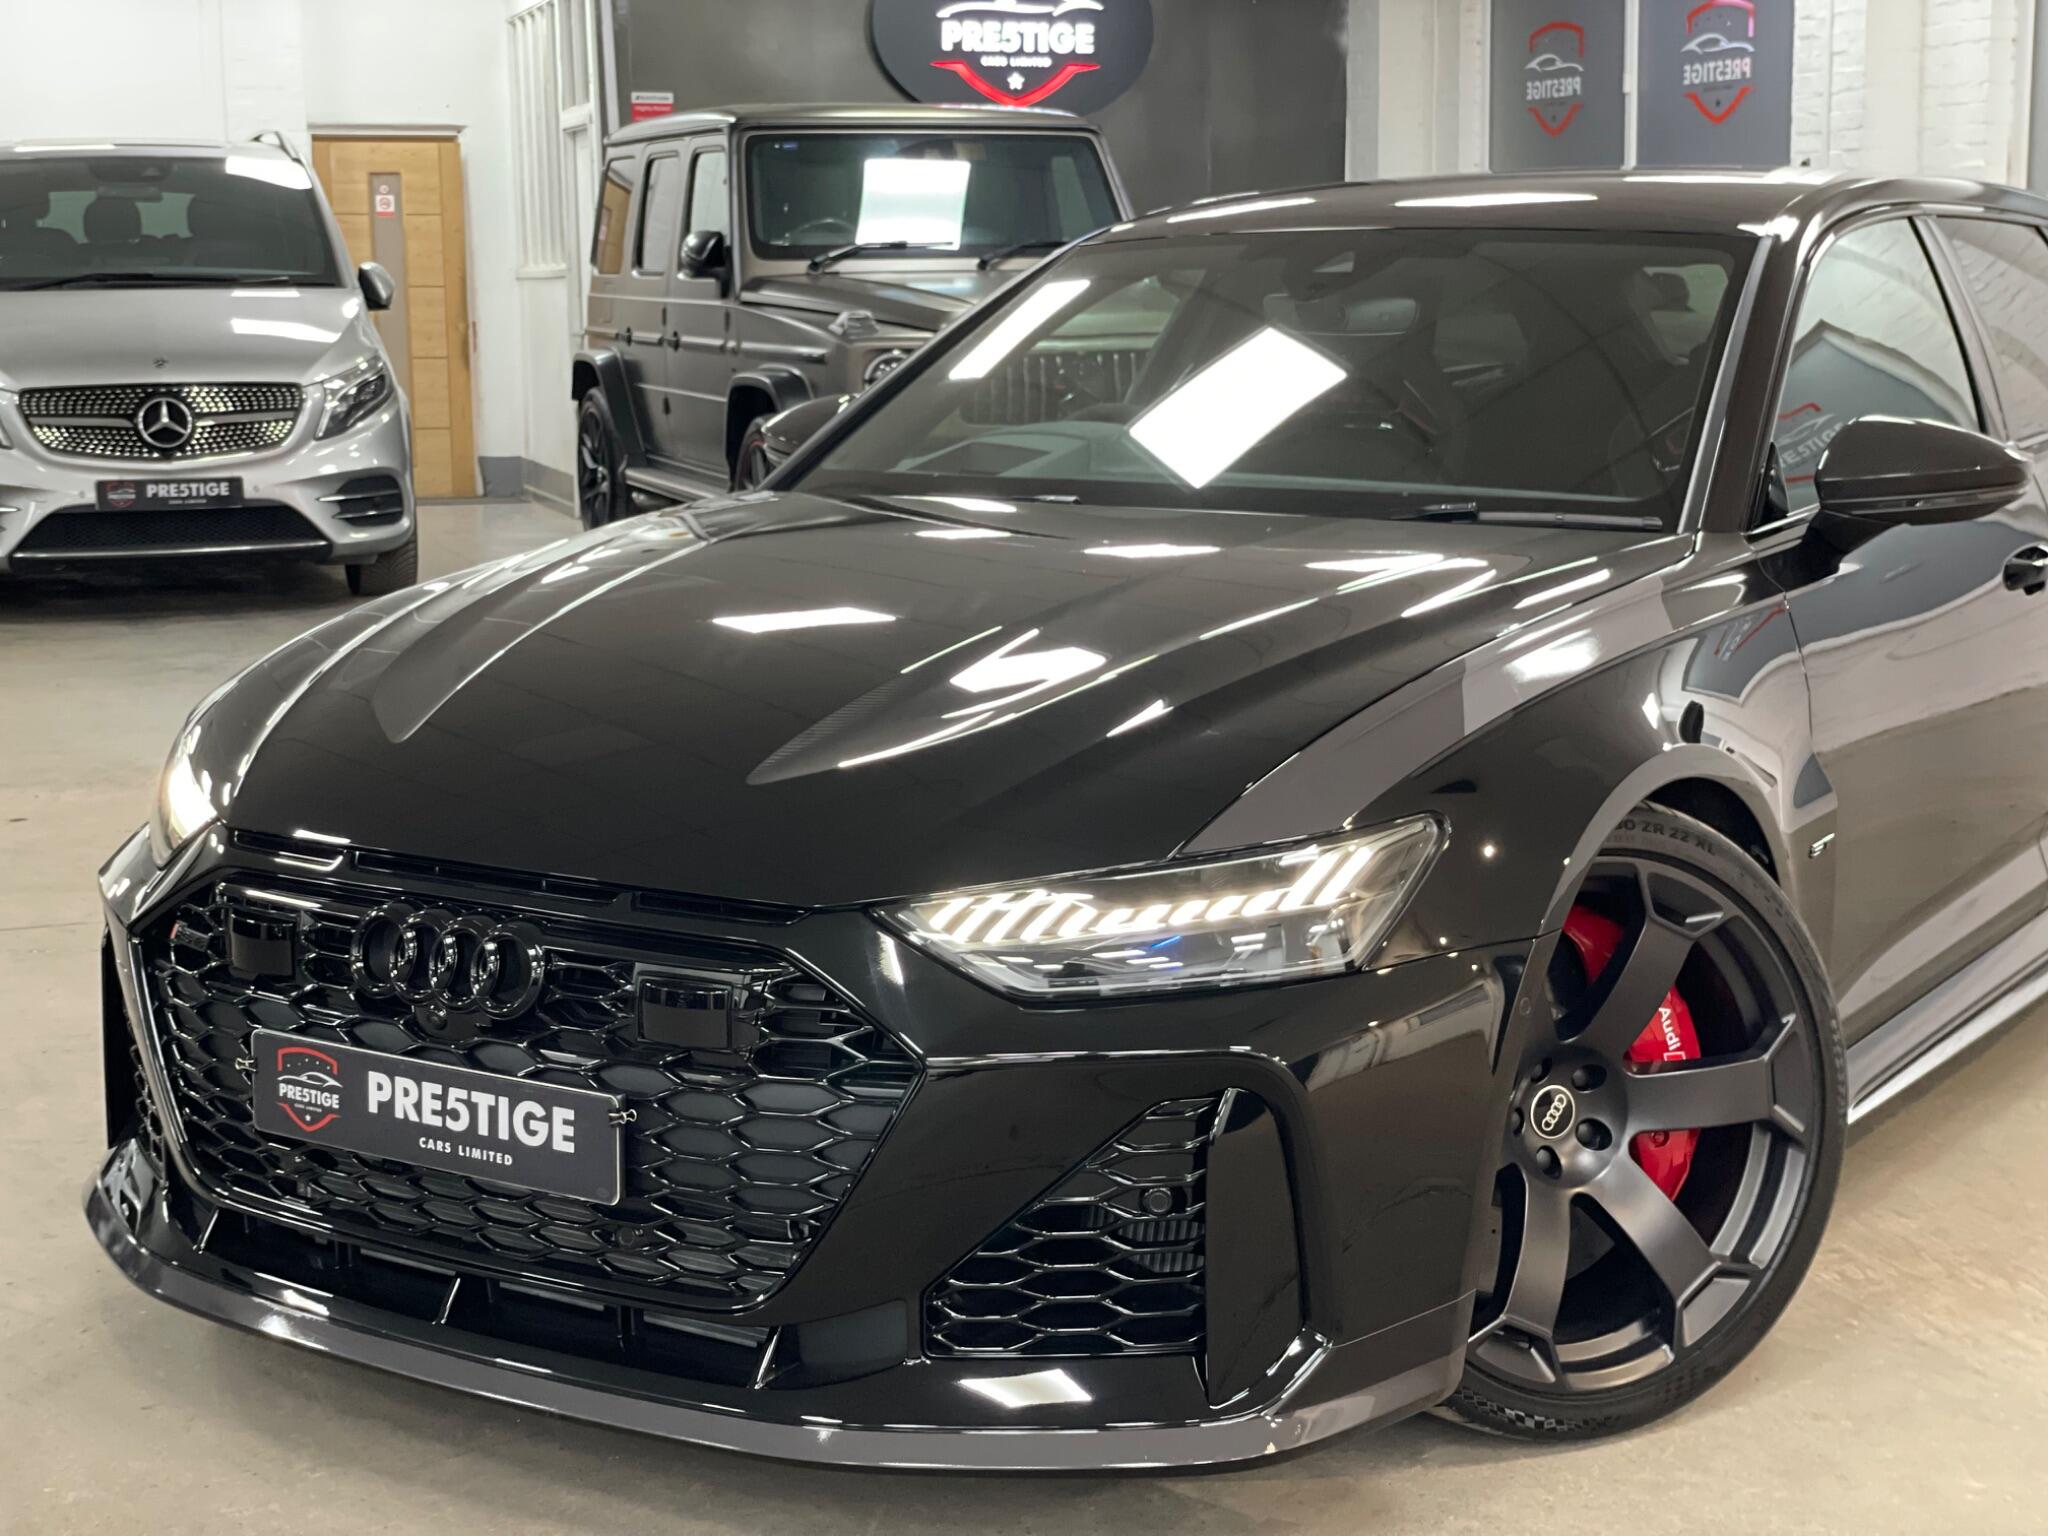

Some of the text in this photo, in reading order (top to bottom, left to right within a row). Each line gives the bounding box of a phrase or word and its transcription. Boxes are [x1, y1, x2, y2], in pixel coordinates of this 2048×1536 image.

[1641, 820, 1665, 836] ZR
[1669, 827, 1690, 843] 22
[1658, 1007, 1681, 1051] Audi
[418, 1137, 513, 1166] CARS LIMITED
